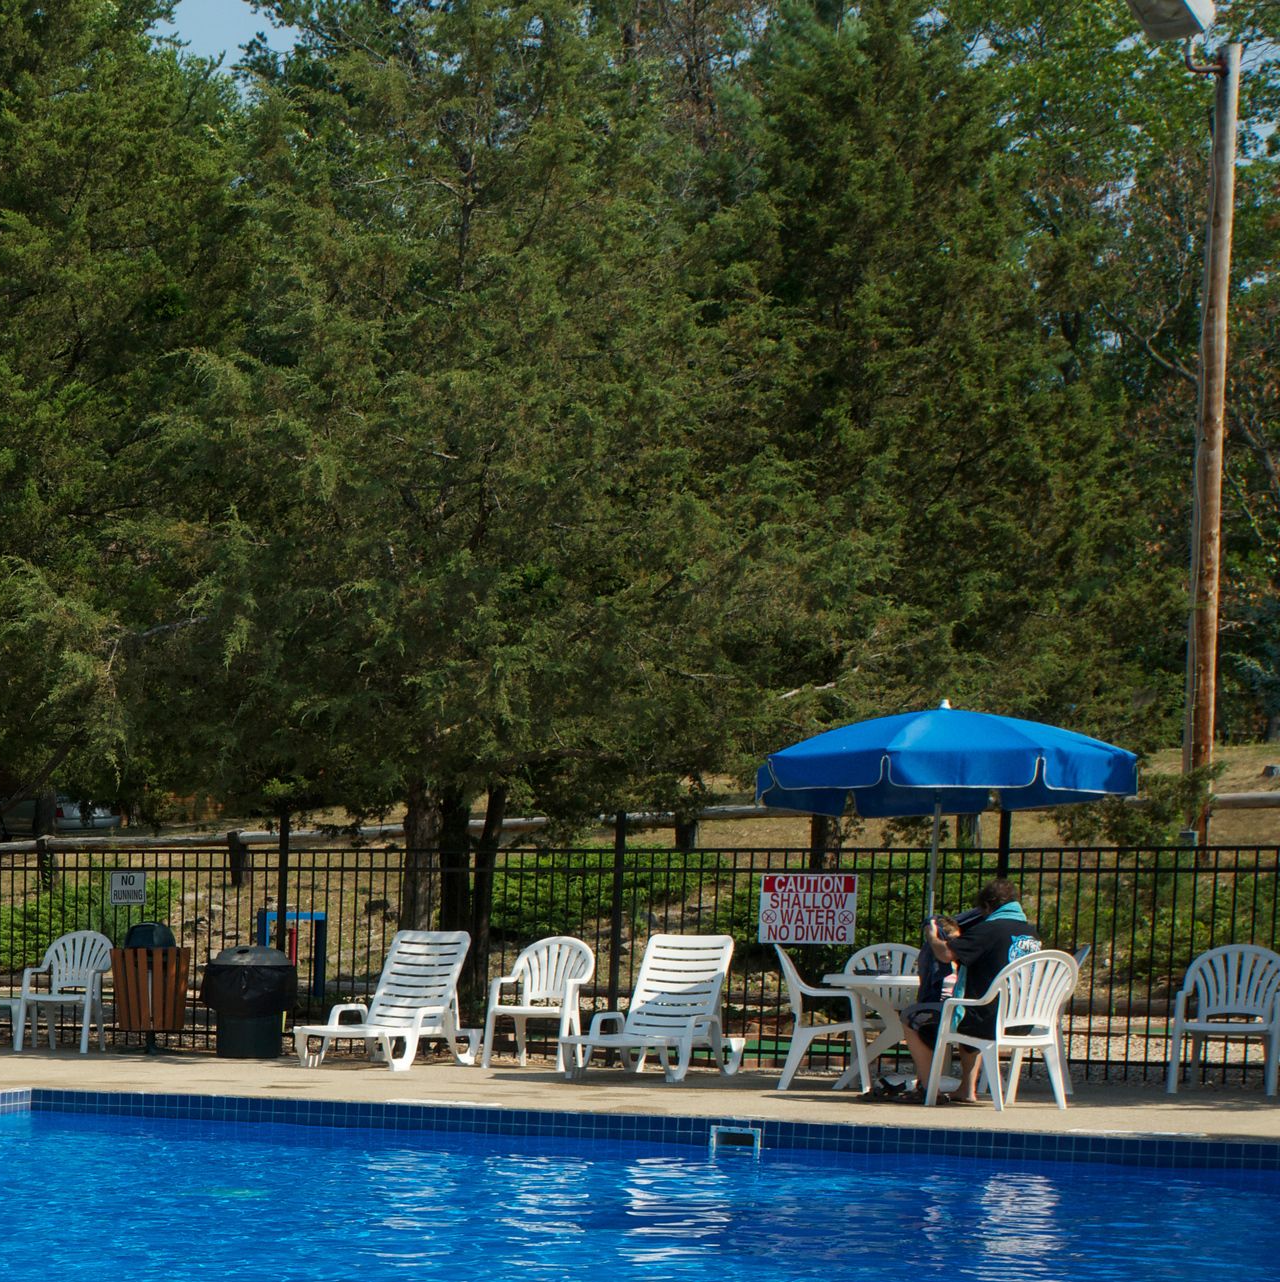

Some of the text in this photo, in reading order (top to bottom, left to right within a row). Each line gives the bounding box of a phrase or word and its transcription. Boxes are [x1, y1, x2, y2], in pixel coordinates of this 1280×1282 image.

[121, 875, 135, 886] NO
[774, 876, 845, 892] CAUTION
[113, 890, 143, 900] RUNNING
[770, 893, 848, 909] SHALLOW
[780, 909, 836, 925] WATER
[767, 925, 847, 942] NO DIVING
